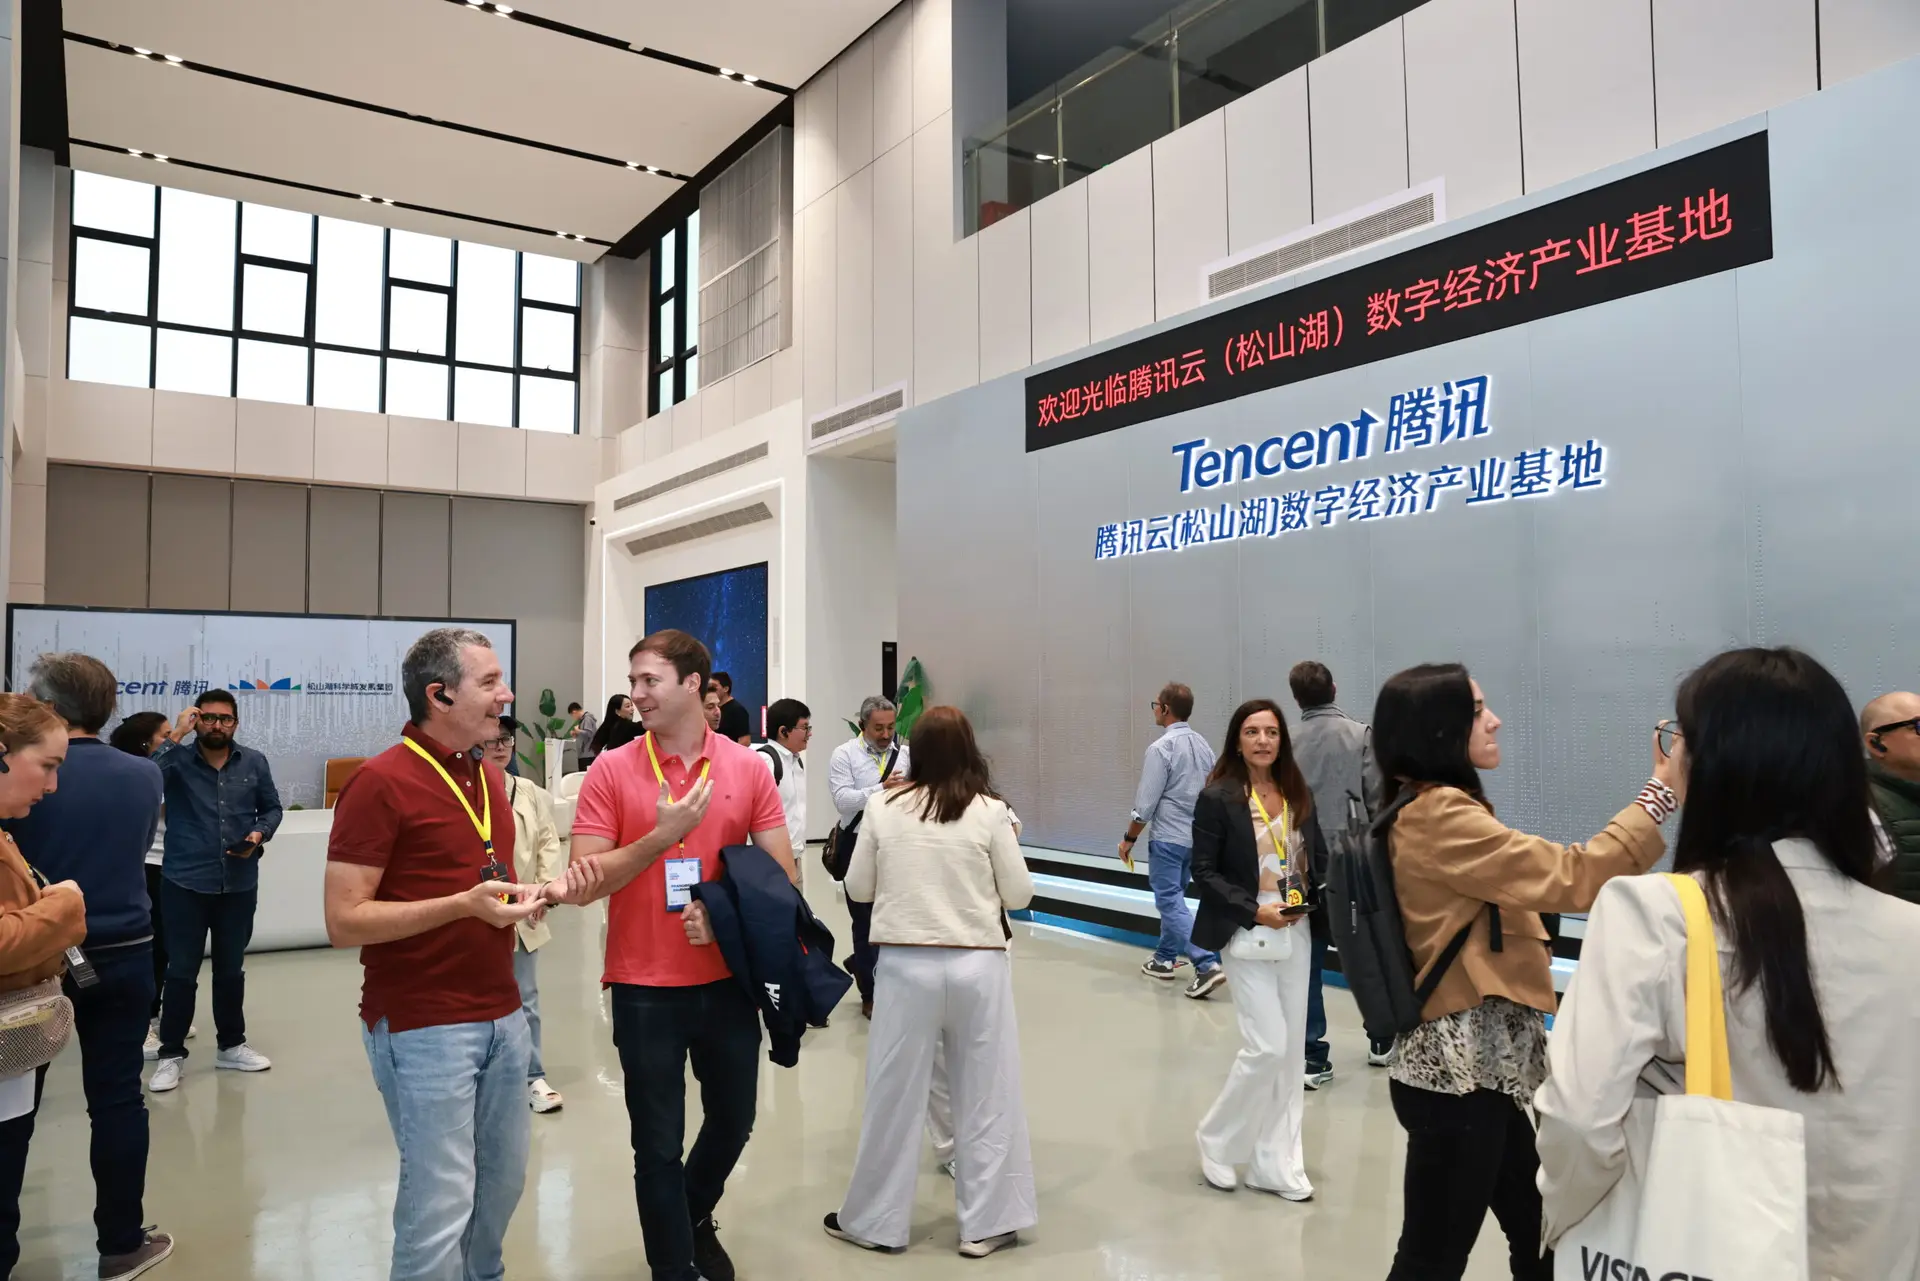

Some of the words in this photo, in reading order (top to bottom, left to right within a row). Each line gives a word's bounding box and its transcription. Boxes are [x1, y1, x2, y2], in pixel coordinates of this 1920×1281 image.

[1171, 409, 1380, 492] Tencent
[1384, 375, 1489, 453] 腾讯
[116, 679, 169, 696] cent
[172, 679, 209, 697] 腾讯
